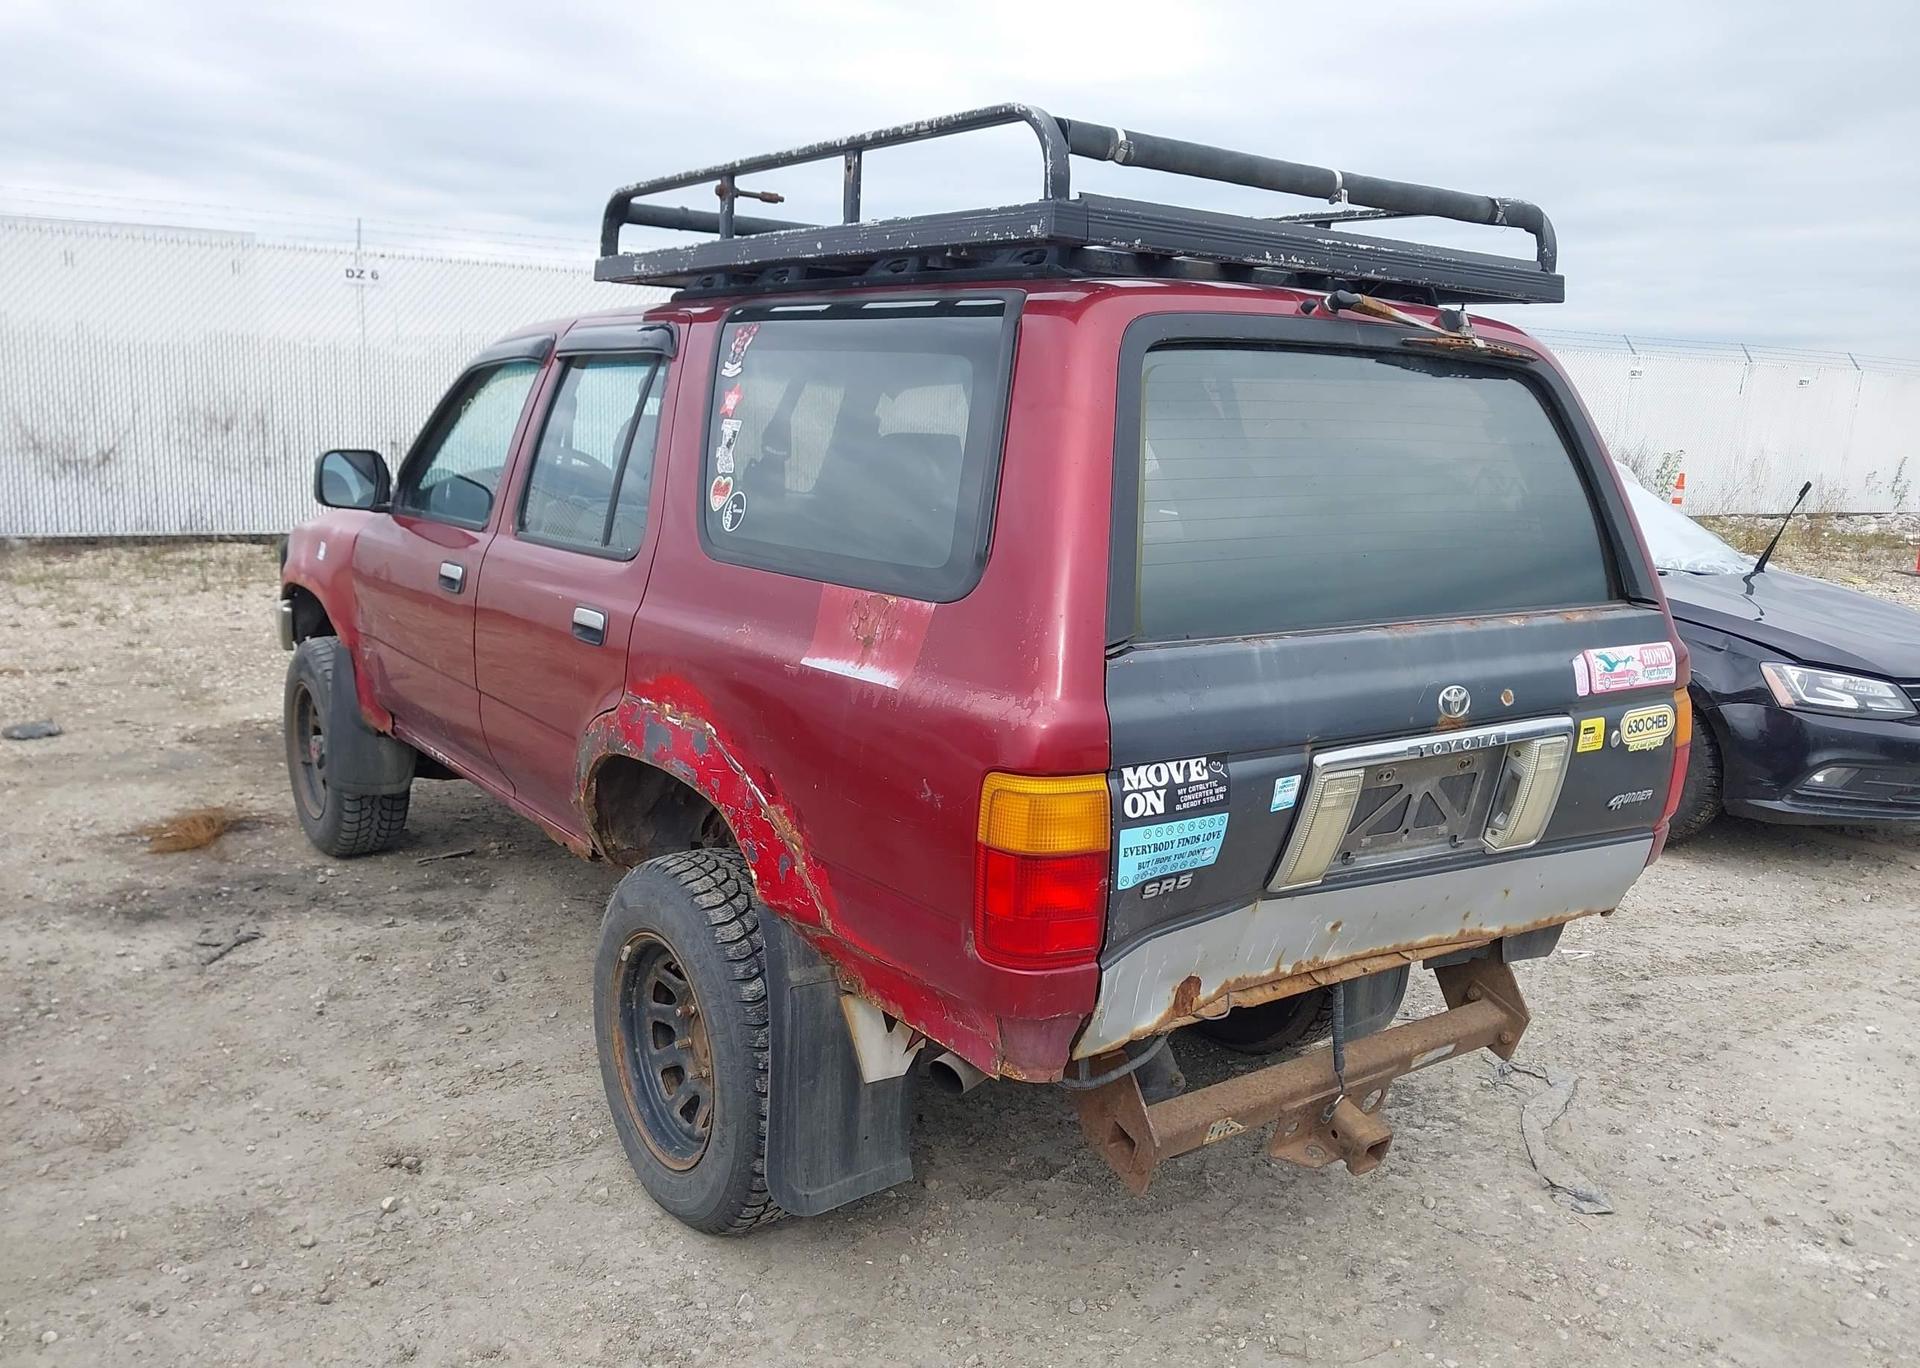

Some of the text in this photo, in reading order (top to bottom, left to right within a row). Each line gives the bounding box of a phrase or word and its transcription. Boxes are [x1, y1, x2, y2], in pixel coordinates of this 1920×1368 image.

[345, 268, 379, 281] DZ 6
[1642, 649, 1670, 664] HONK!
[1627, 714, 1668, 735] 630 CHEB
[1419, 734, 1499, 757] TOYOTA
[1121, 757, 1209, 792] MOVE
[1180, 786, 1227, 803] CONVERTER WAS
[1188, 780, 1218, 793] CATALYTIC
[1123, 789, 1167, 819] ON
[1175, 793, 1224, 811] ALREADY STOLEN
[1123, 830, 1222, 858] EVERYBODY FINDS LOVE
[1137, 860, 1151, 871] BUT
[1155, 857, 1173, 867] HOPE
[1173, 852, 1187, 862] YOU
[1142, 872, 1193, 900] SR5
